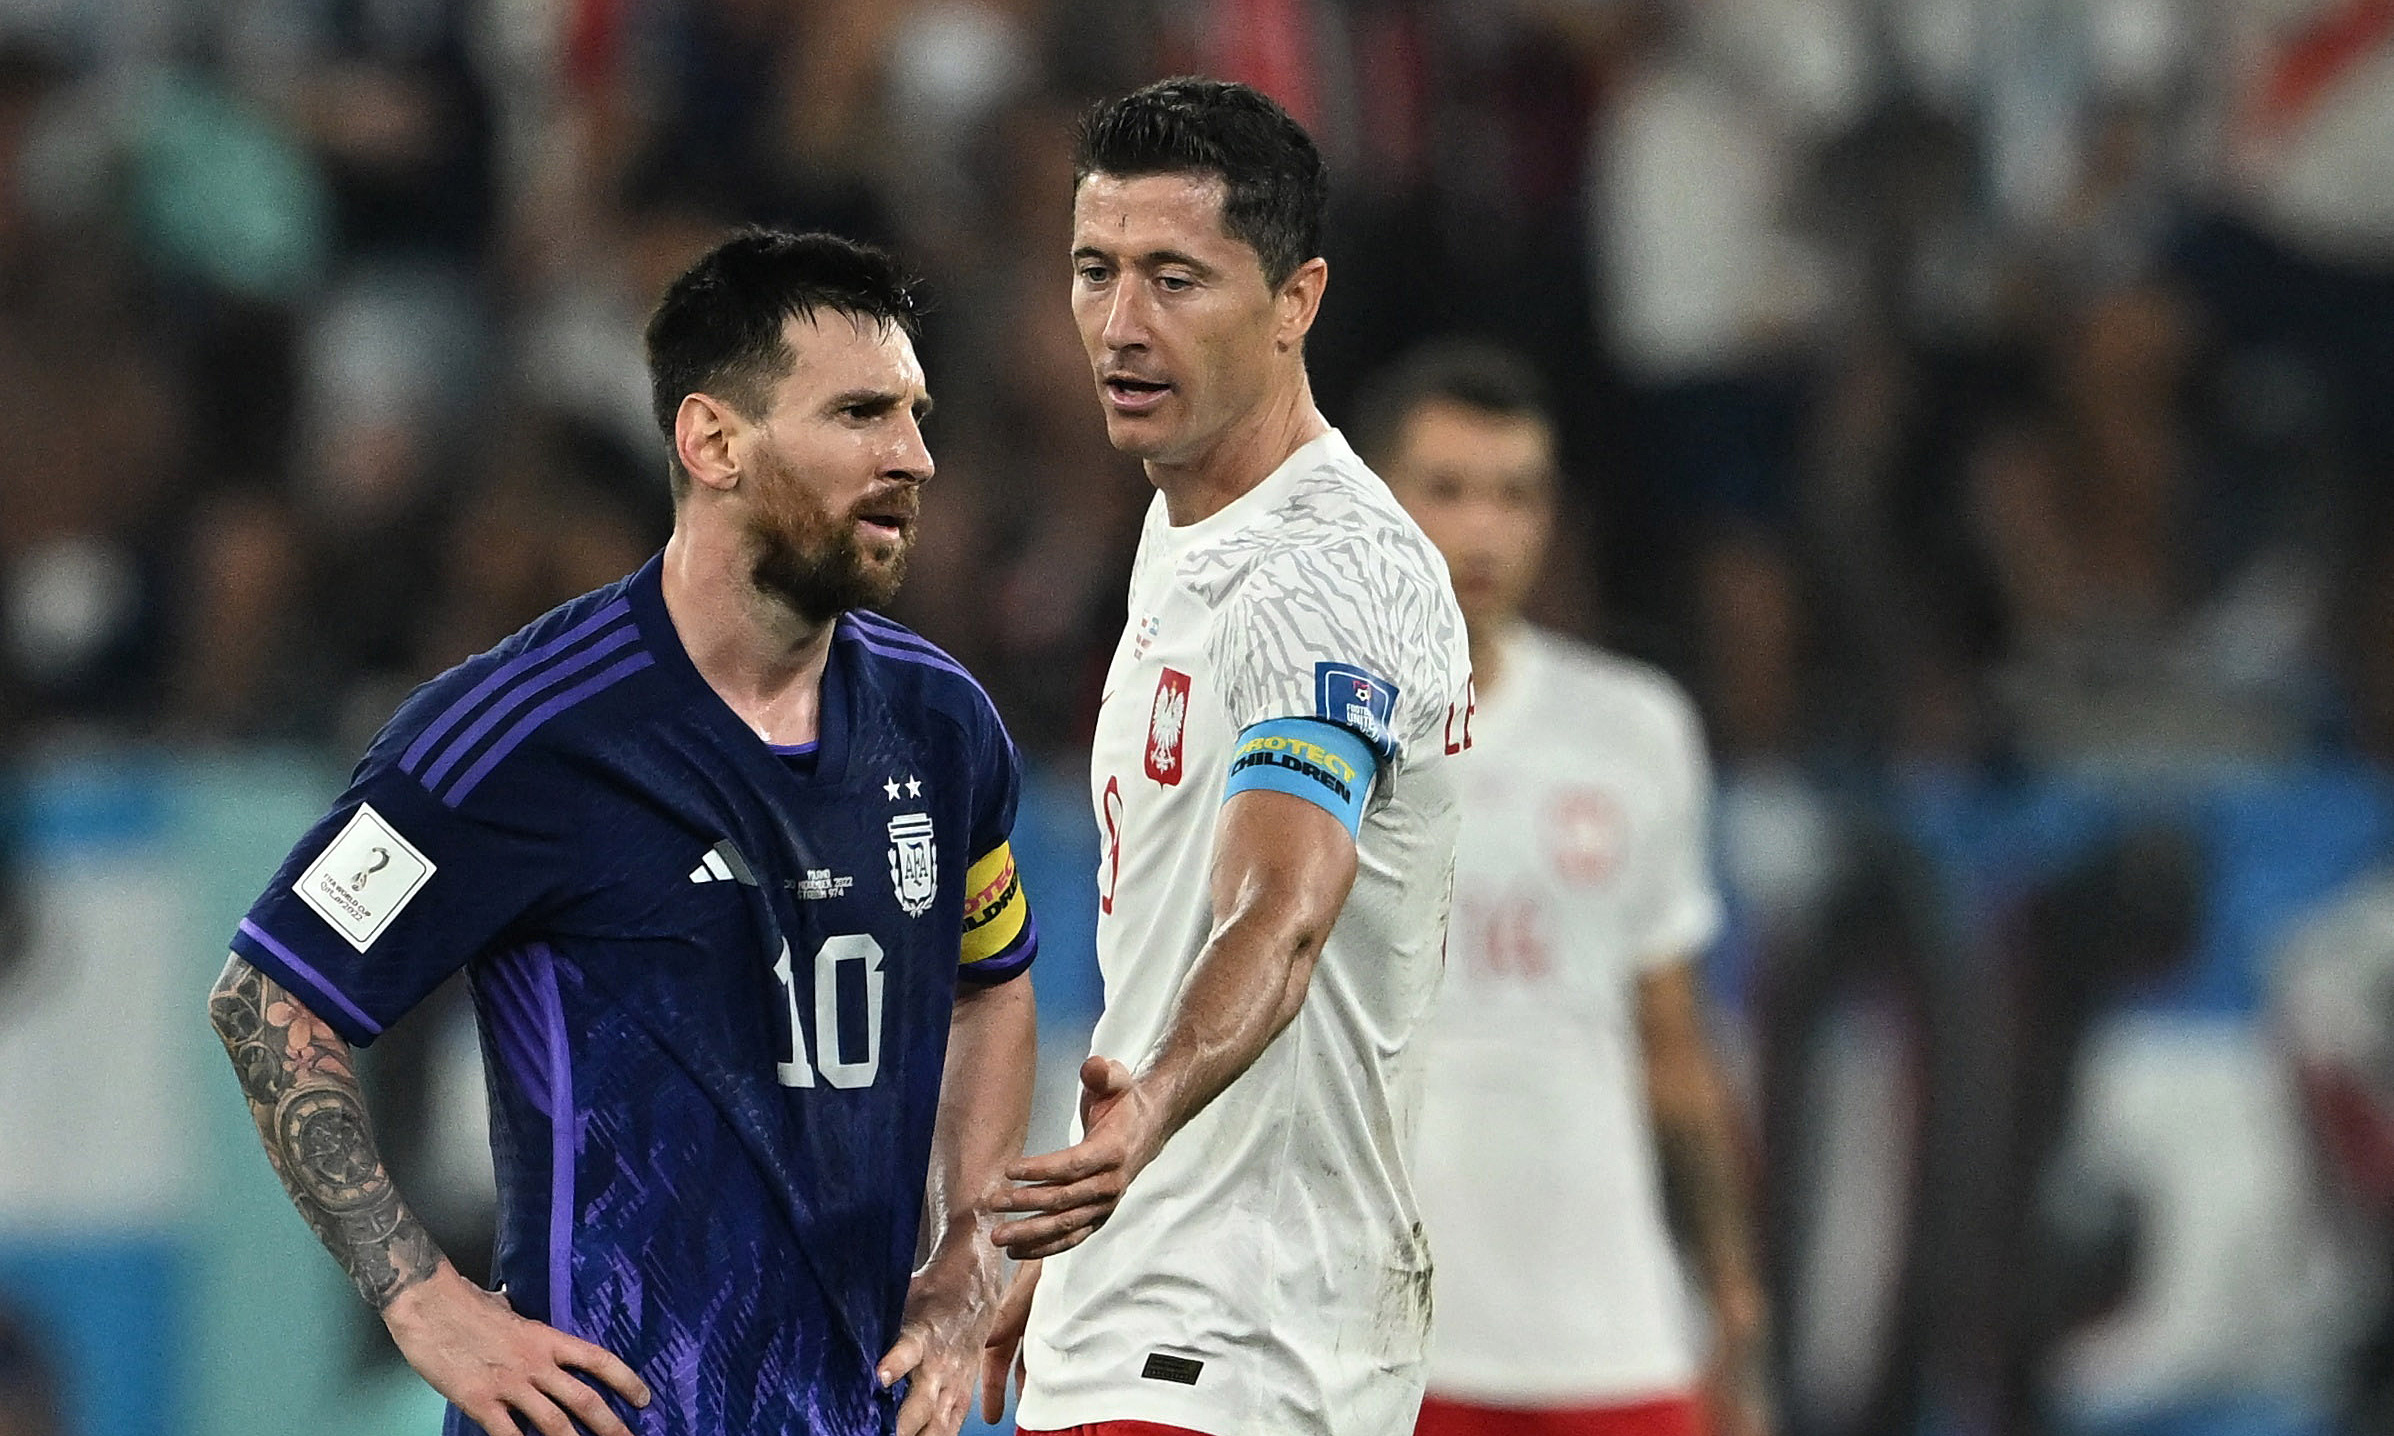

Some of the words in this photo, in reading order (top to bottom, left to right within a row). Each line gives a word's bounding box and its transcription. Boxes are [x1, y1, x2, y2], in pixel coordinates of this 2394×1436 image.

[1231, 752, 1351, 804] CHILDREN
[336, 885, 359, 907] WORLD
[773, 934, 885, 1089] 10
